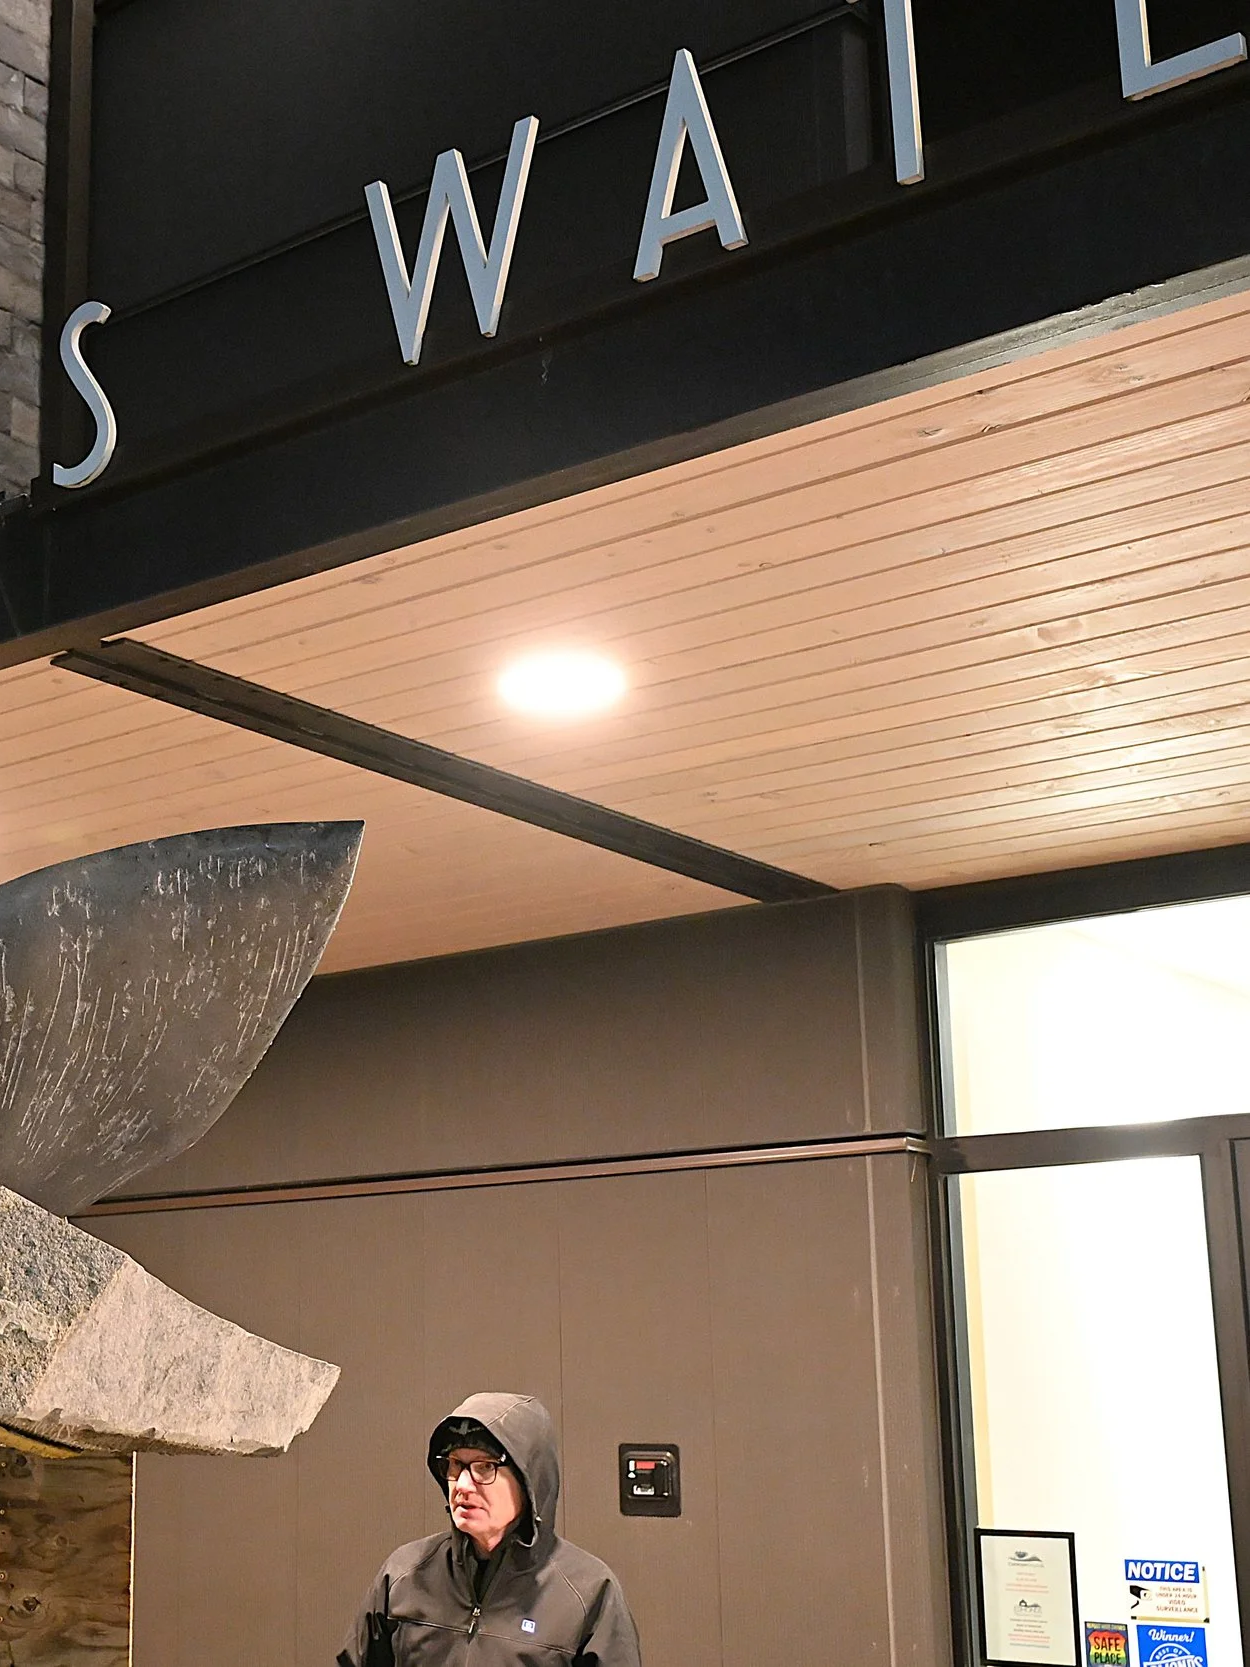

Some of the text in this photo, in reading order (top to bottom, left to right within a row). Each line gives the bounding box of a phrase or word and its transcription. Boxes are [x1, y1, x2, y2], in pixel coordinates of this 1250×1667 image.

[1128, 1562, 1196, 1581] NOTICE
[1148, 1628, 1195, 1643] Winner!
[1093, 1636, 1121, 1651] SAFE
[1094, 1652, 1121, 1665] PLACE
